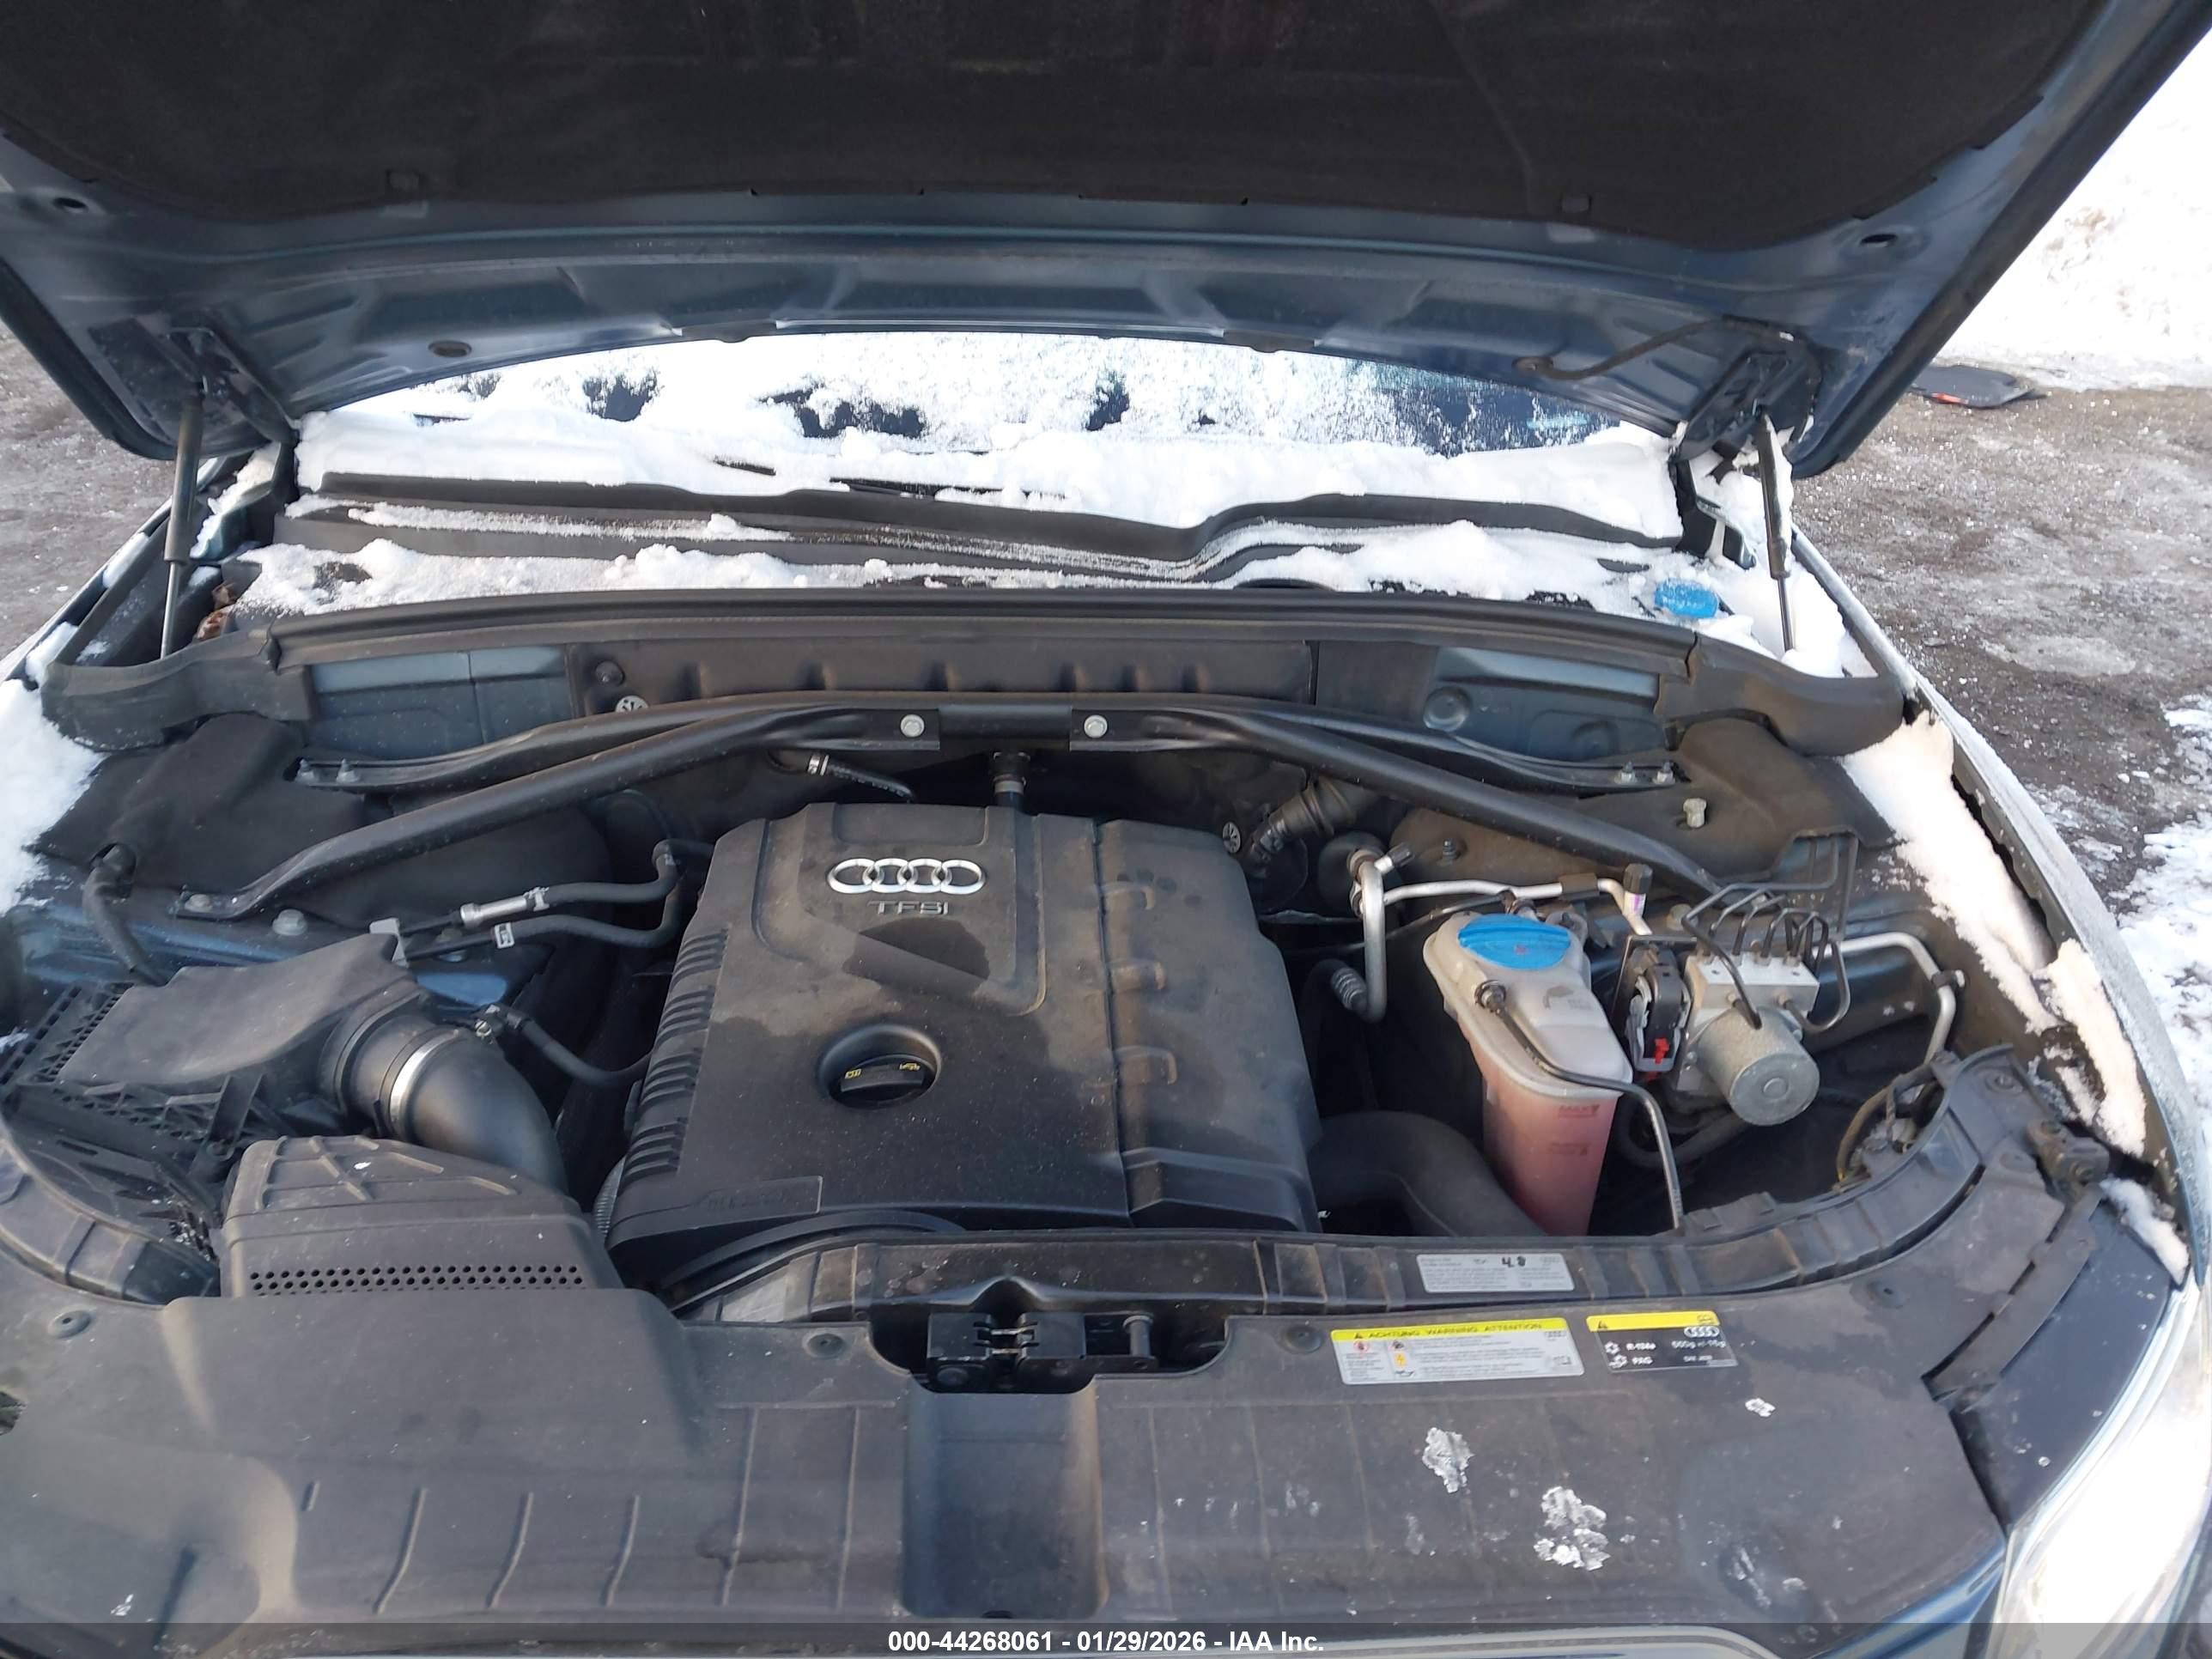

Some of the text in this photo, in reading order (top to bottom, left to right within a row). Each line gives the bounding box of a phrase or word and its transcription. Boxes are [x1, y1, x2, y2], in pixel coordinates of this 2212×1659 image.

[866, 901, 949, 915] TFSI
[1425, 1327, 1478, 1336] WARNING
[1485, 1323, 1542, 1332] ATTENTION
